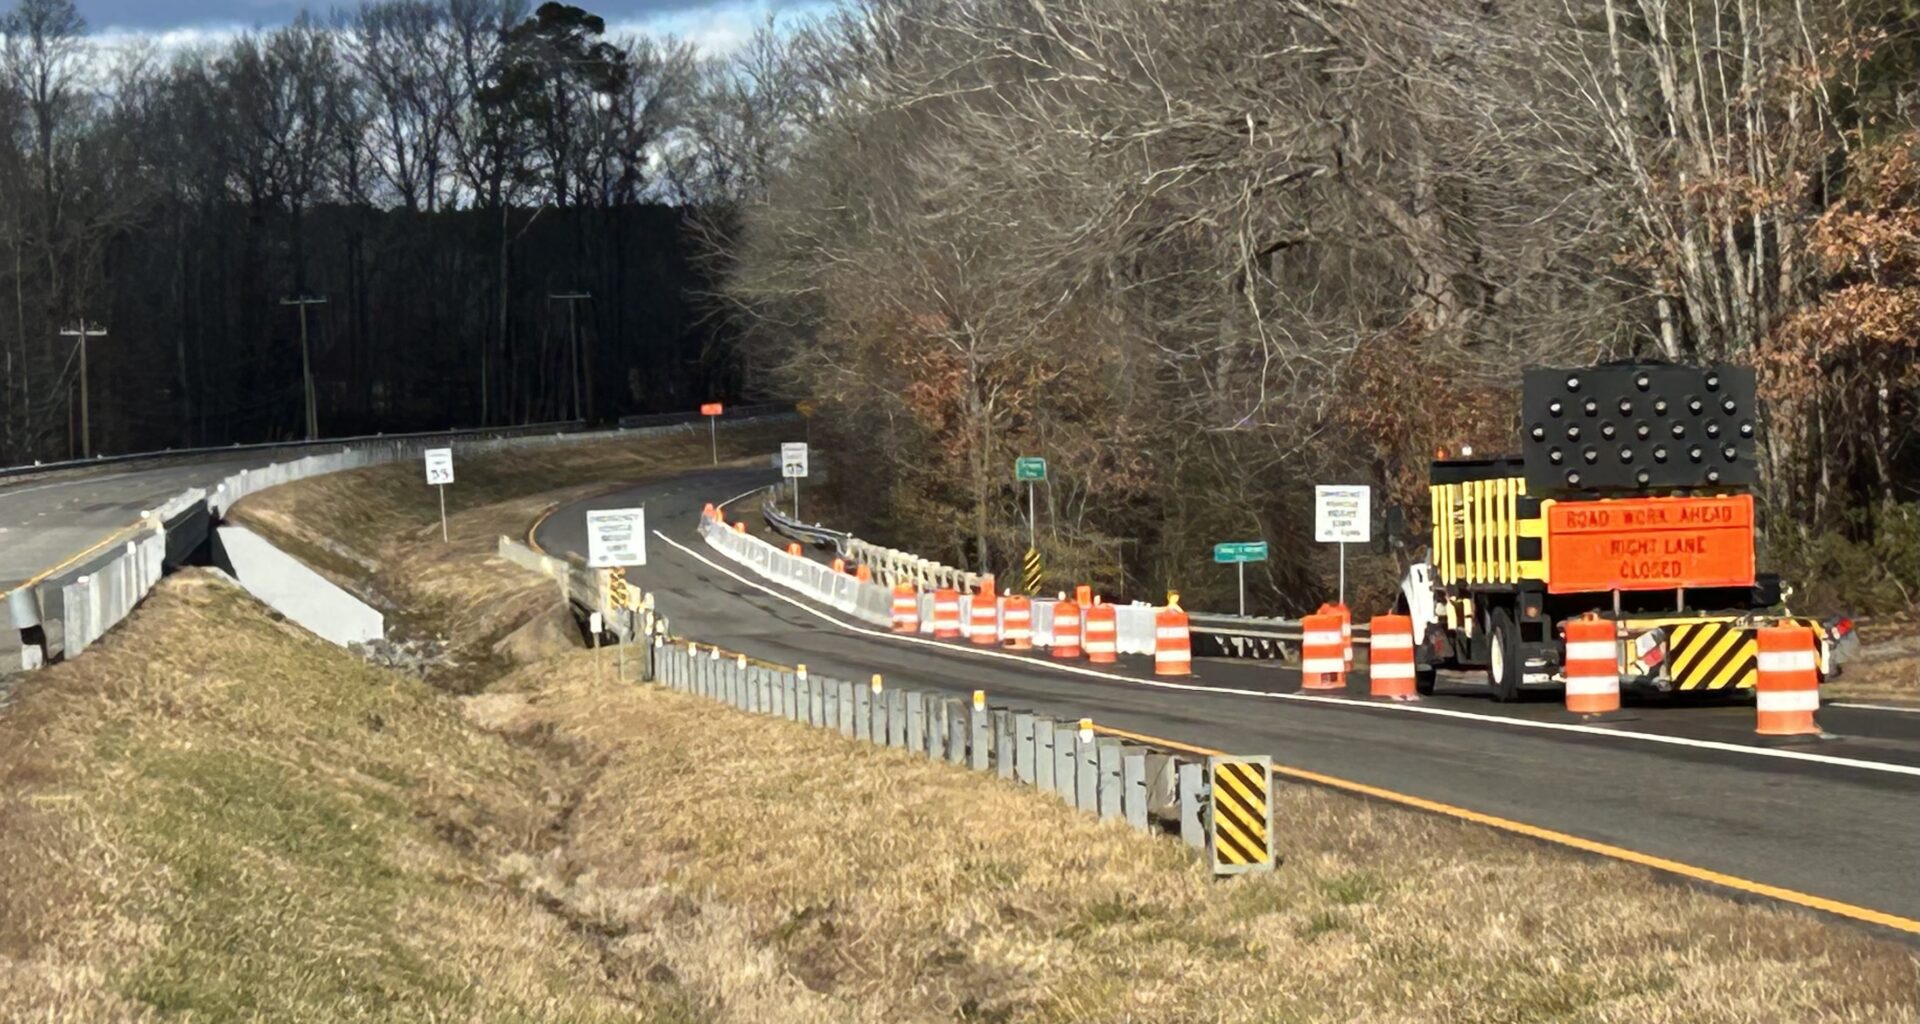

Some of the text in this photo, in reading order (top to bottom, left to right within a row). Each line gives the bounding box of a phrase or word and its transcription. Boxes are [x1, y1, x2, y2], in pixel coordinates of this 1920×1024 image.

[1567, 506, 1733, 528] ROAD WORK AHEAD
[1611, 536, 1708, 556] RIGHT LANE
[1620, 561, 1682, 579] CLOSED
